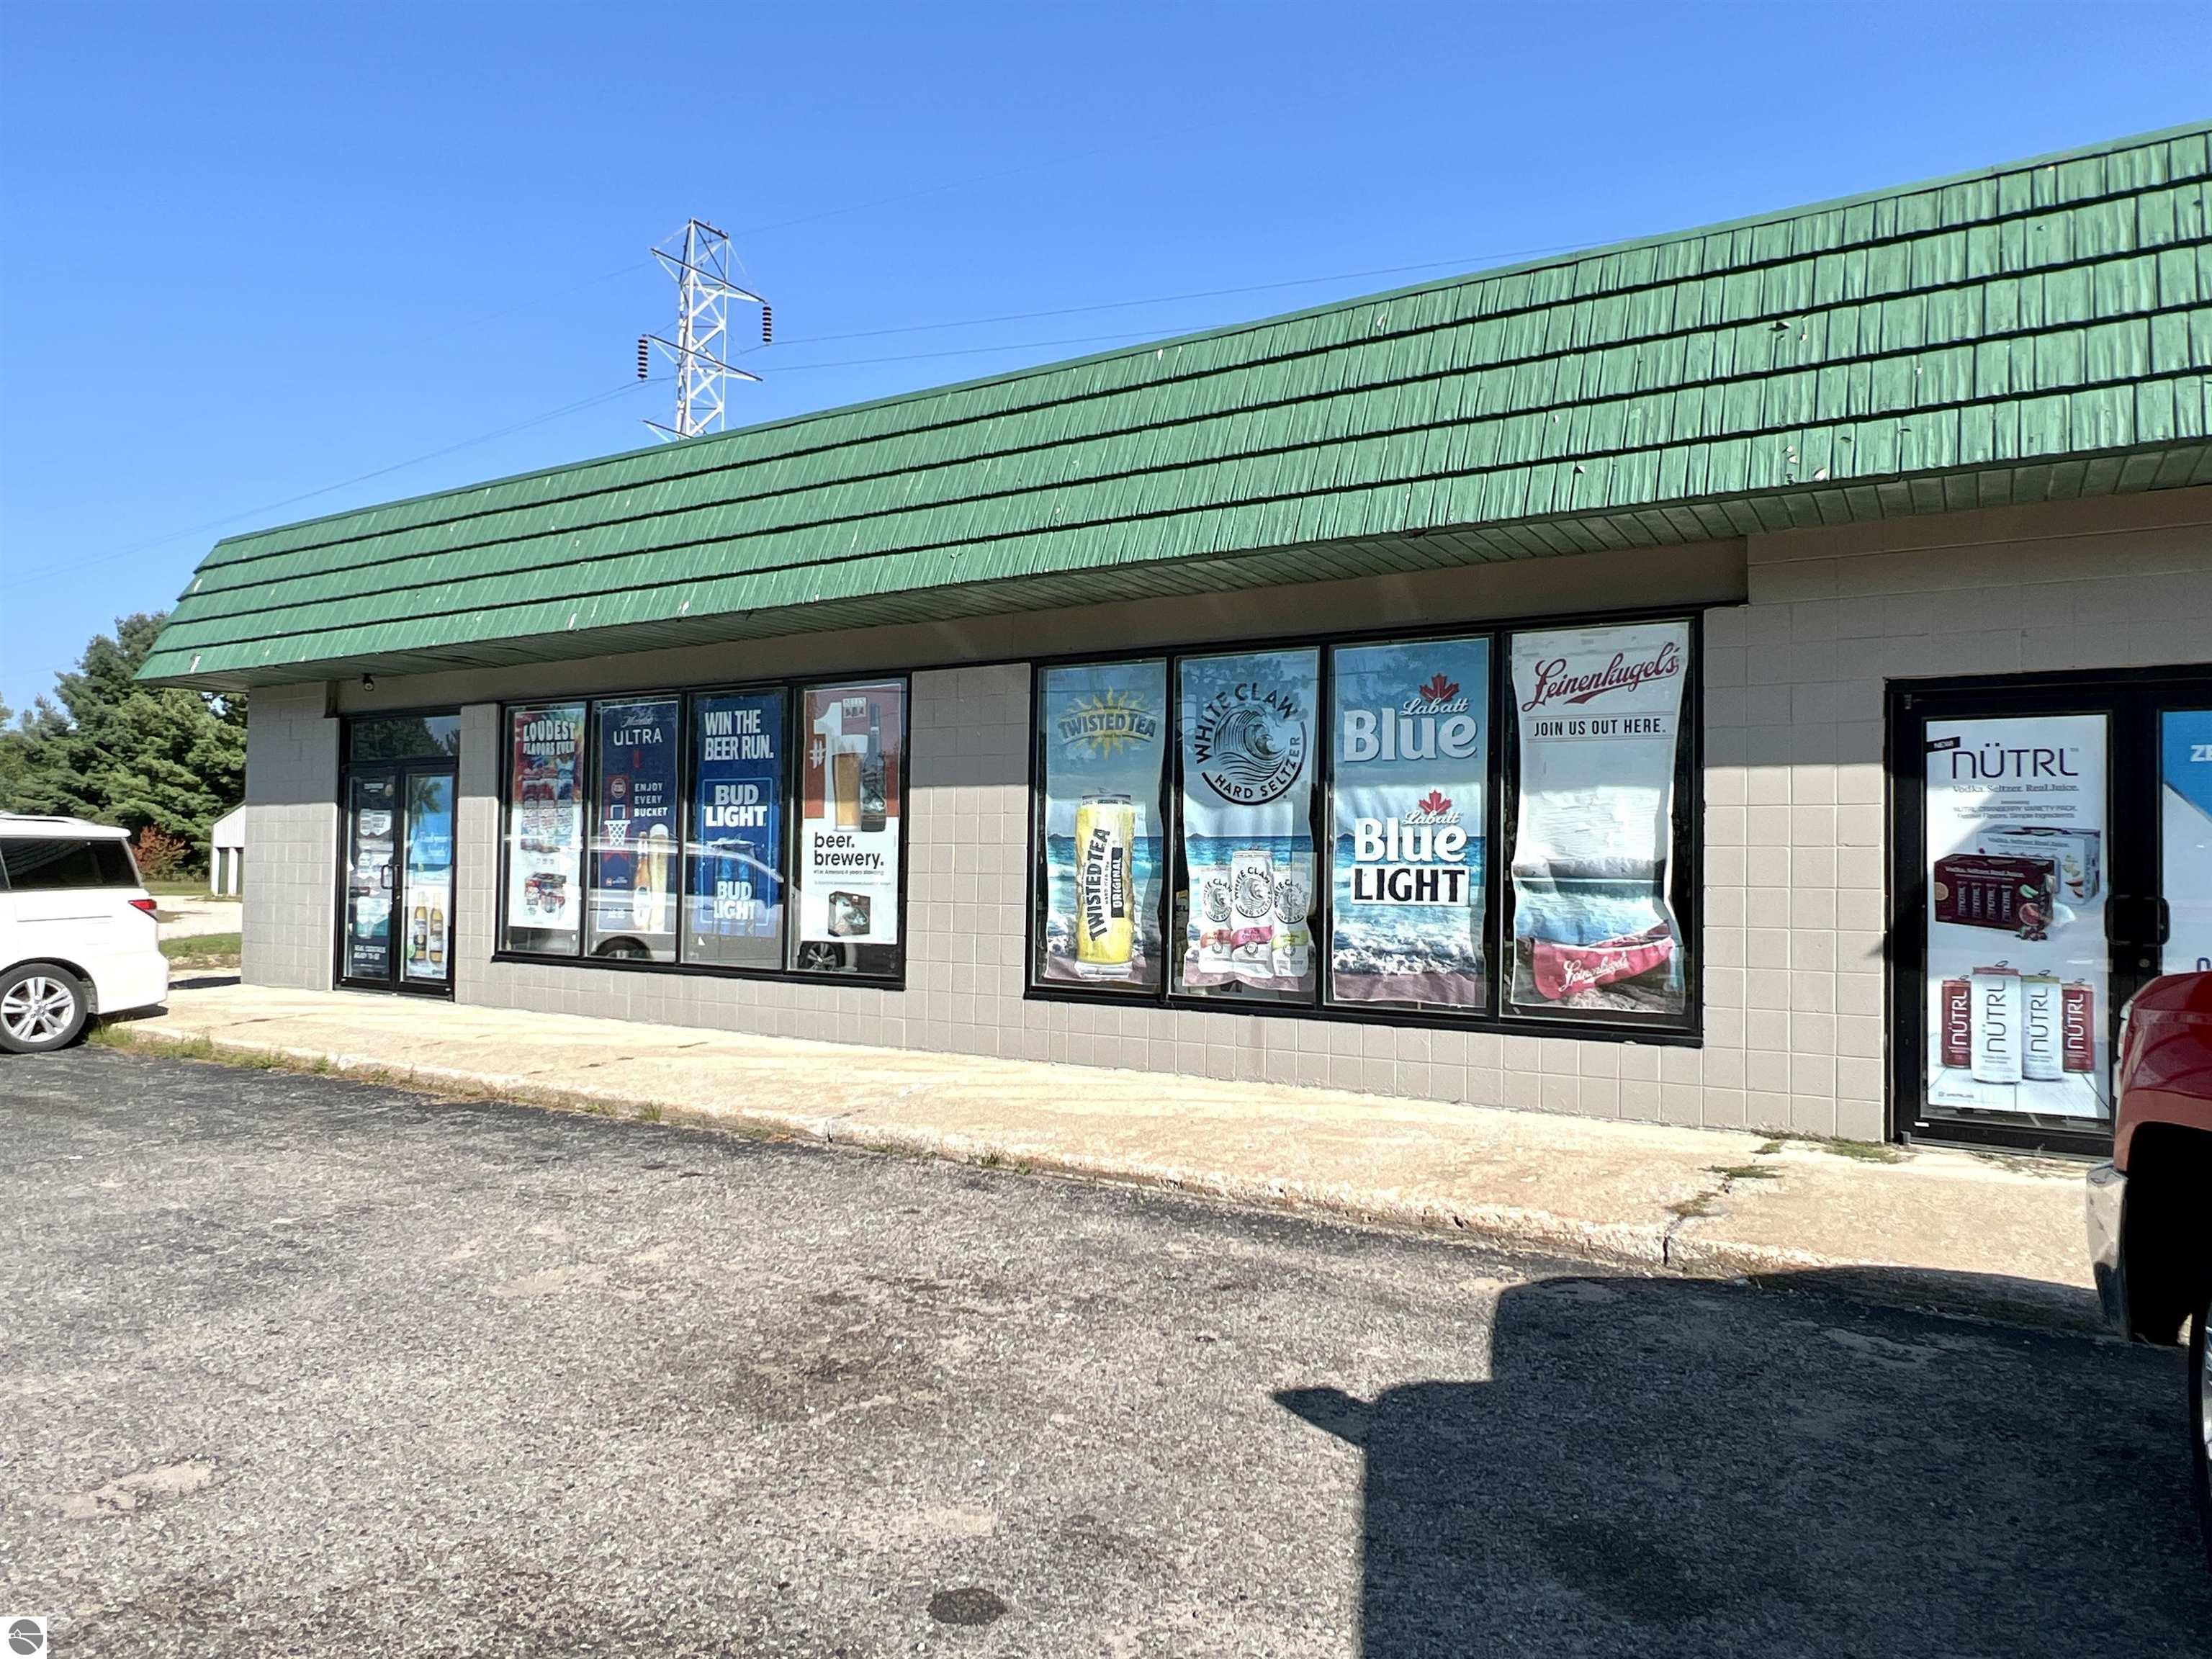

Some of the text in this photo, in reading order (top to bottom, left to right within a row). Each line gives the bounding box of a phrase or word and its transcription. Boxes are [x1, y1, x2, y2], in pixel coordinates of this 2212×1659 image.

[1399, 697, 1470, 716] Labatt
[523, 720, 575, 742] LOUDEST
[705, 709, 761, 735] WIN THE
[1058, 713, 1156, 739] TWISTED TEA
[1194, 682, 1298, 765] WHITE CLAW
[1534, 718, 1666, 737] JOIN US OUT HERE.
[613, 727, 663, 746] ULTRA
[1344, 708, 1478, 762] Blue
[704, 734, 774, 760] BEER RUN.
[1214, 737, 1301, 799] HARD SELTZER
[634, 782, 663, 792] ENJOY
[715, 783, 759, 805] BUD
[634, 794, 662, 805] EVERY
[634, 806, 668, 817] BUCKET
[705, 805, 768, 827] LIGHT
[1401, 810, 1461, 825] Labatt
[814, 832, 855, 848] beer.
[1087, 827, 1110, 860] TEA
[1354, 817, 1467, 863] Blue
[814, 850, 884, 870] brewery.
[717, 881, 752, 900] BUD
[1112, 858, 1123, 908] ORIGINAL
[1354, 868, 1465, 902] LIGHT
[714, 899, 755, 920] LIGHT
[1086, 863, 1107, 941] TWISTED
